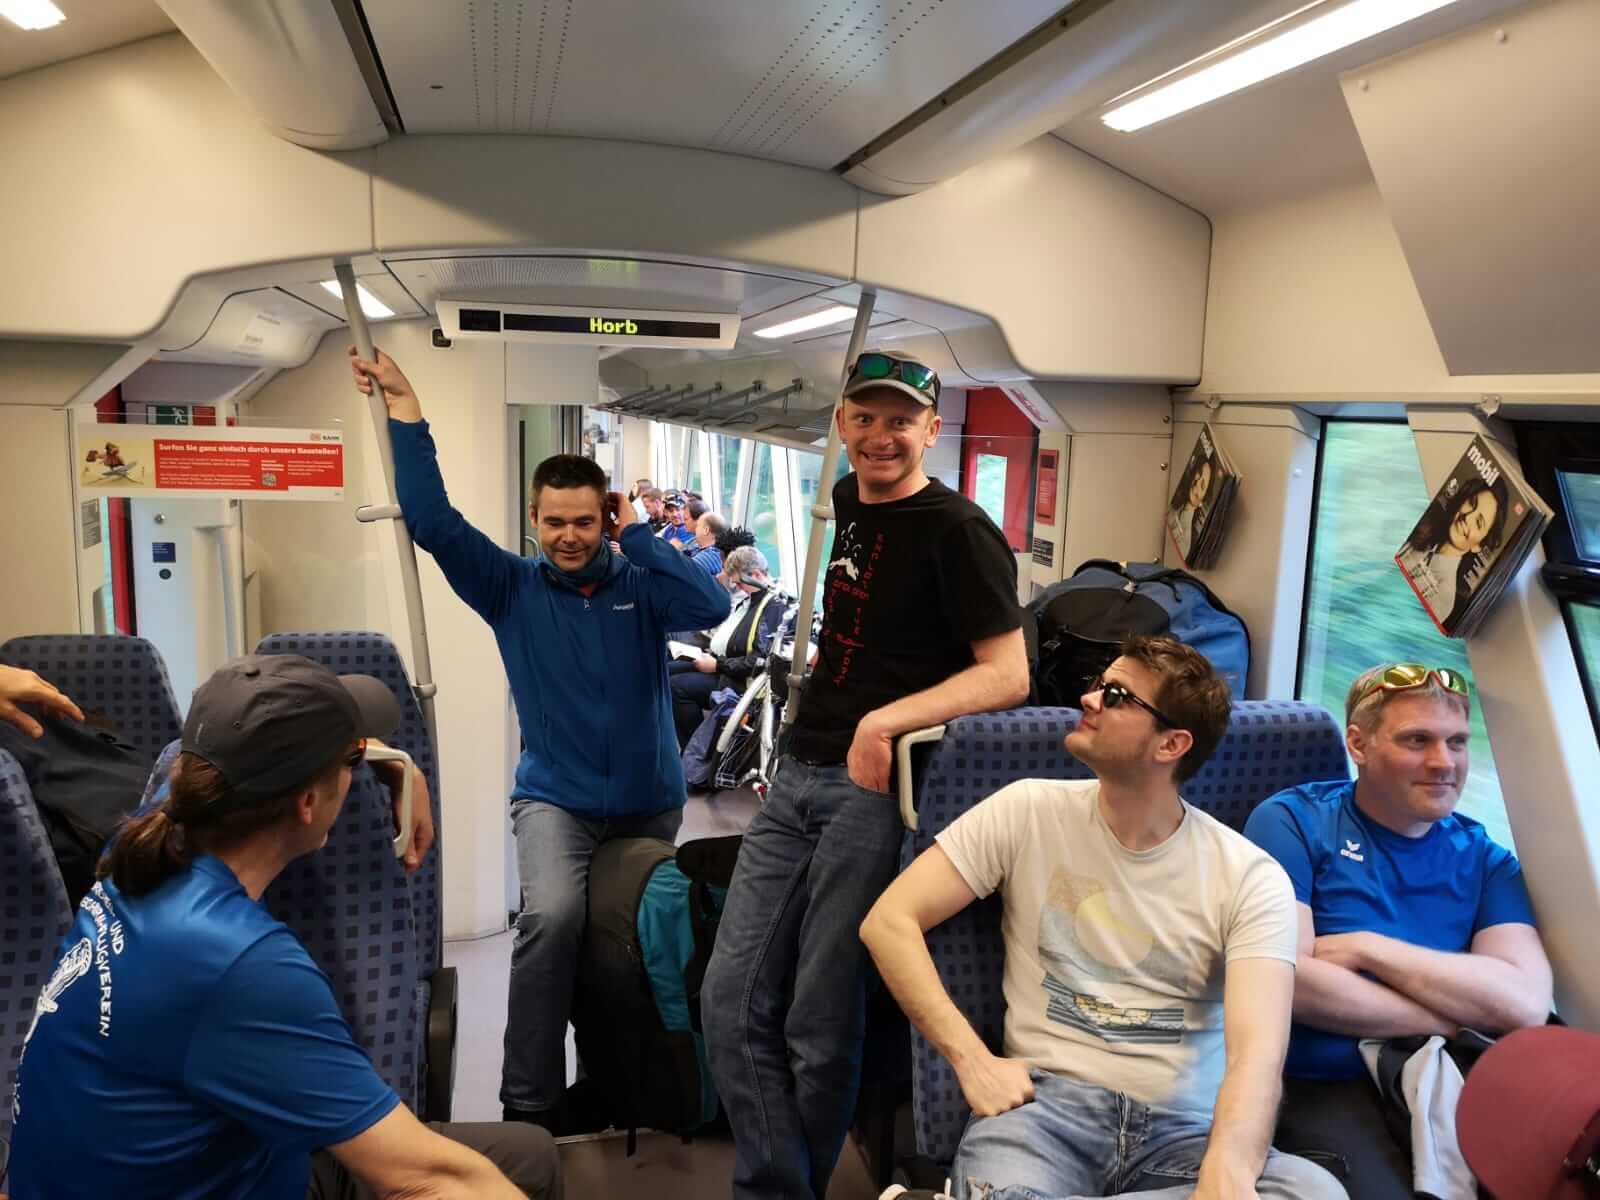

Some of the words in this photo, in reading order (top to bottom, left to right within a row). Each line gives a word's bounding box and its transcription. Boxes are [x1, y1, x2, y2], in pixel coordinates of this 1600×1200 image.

[589, 317, 638, 335] Horb
[186, 444, 197, 452] Sie
[199, 445, 217, 454] ganz
[218, 445, 246, 453] einfach
[247, 446, 269, 454] durch
[1467, 444, 1500, 487] mobil
[110, 920, 124, 954] UND
